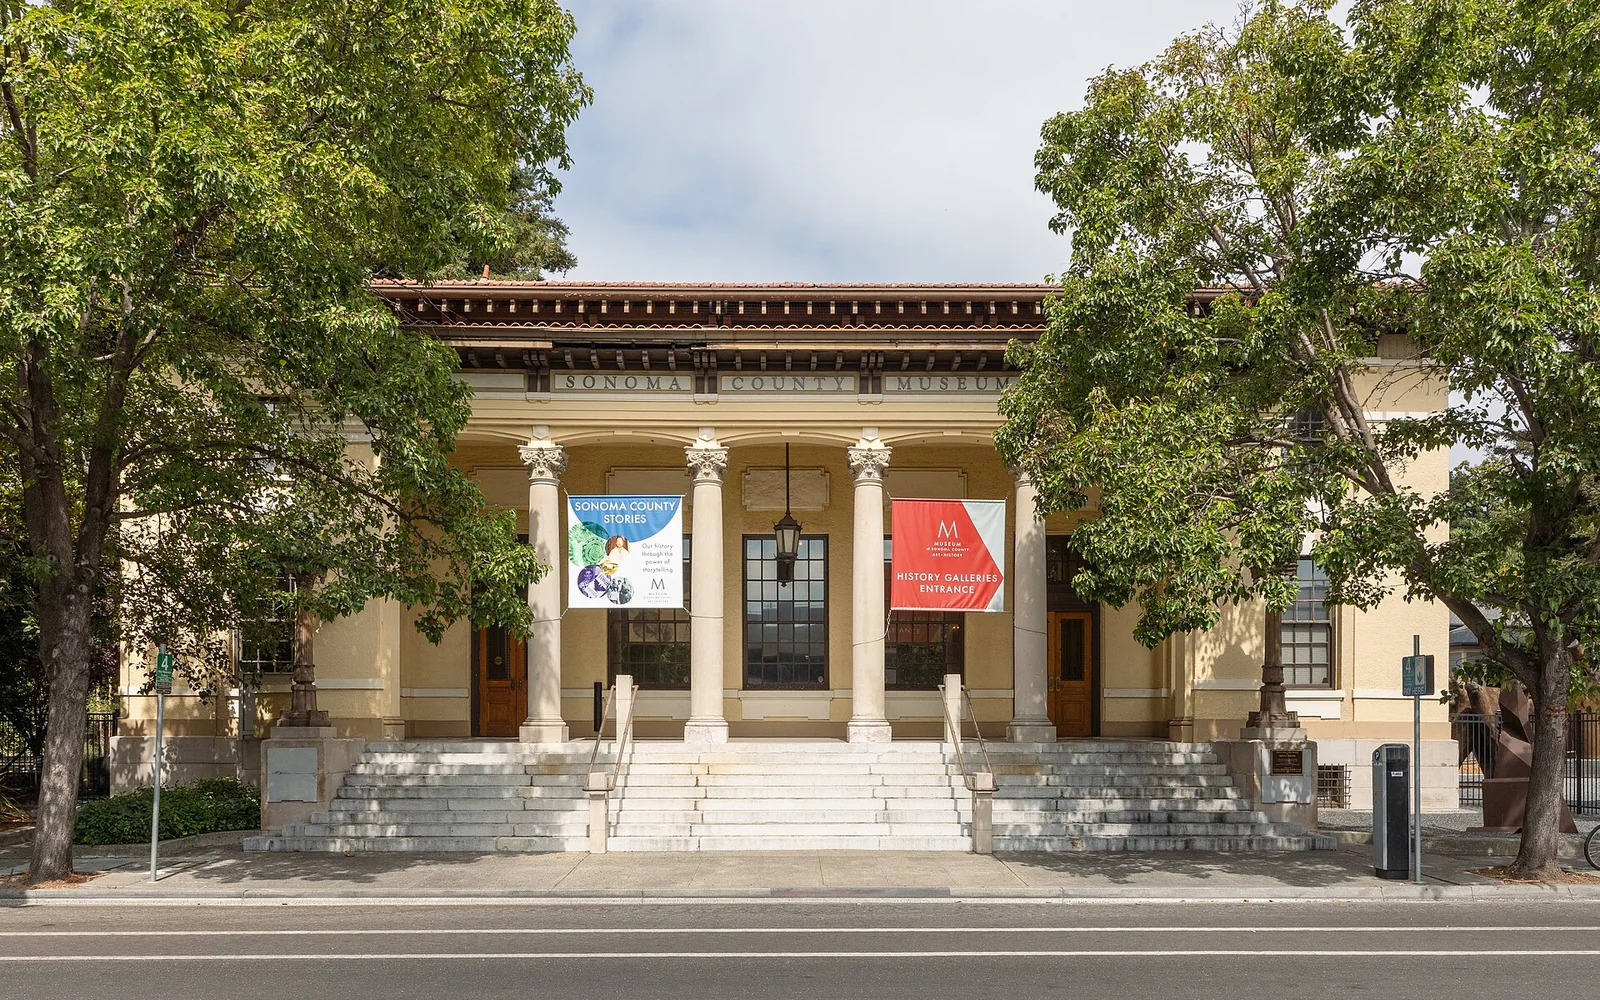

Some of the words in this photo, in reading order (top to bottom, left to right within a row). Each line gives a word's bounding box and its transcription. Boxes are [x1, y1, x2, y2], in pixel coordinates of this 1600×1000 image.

[565, 375, 682, 390] SONOMA
[731, 376, 845, 390] COUNTY
[896, 376, 1010, 391] MUSEUM
[575, 501, 627, 511] SONOMA
[629, 501, 676, 511] COUNTY
[603, 514, 647, 524] STORIES
[938, 520, 958, 538] M
[642, 566, 674, 574] storytelling
[897, 572, 941, 581] HISTORY
[944, 573, 998, 583] GALLERIES
[651, 578, 665, 590] M
[920, 584, 975, 594] ENTRANCE
[161, 655, 169, 671] 4
[1406, 658, 1412, 673] 4
[1412, 686, 1424, 695] HERE
